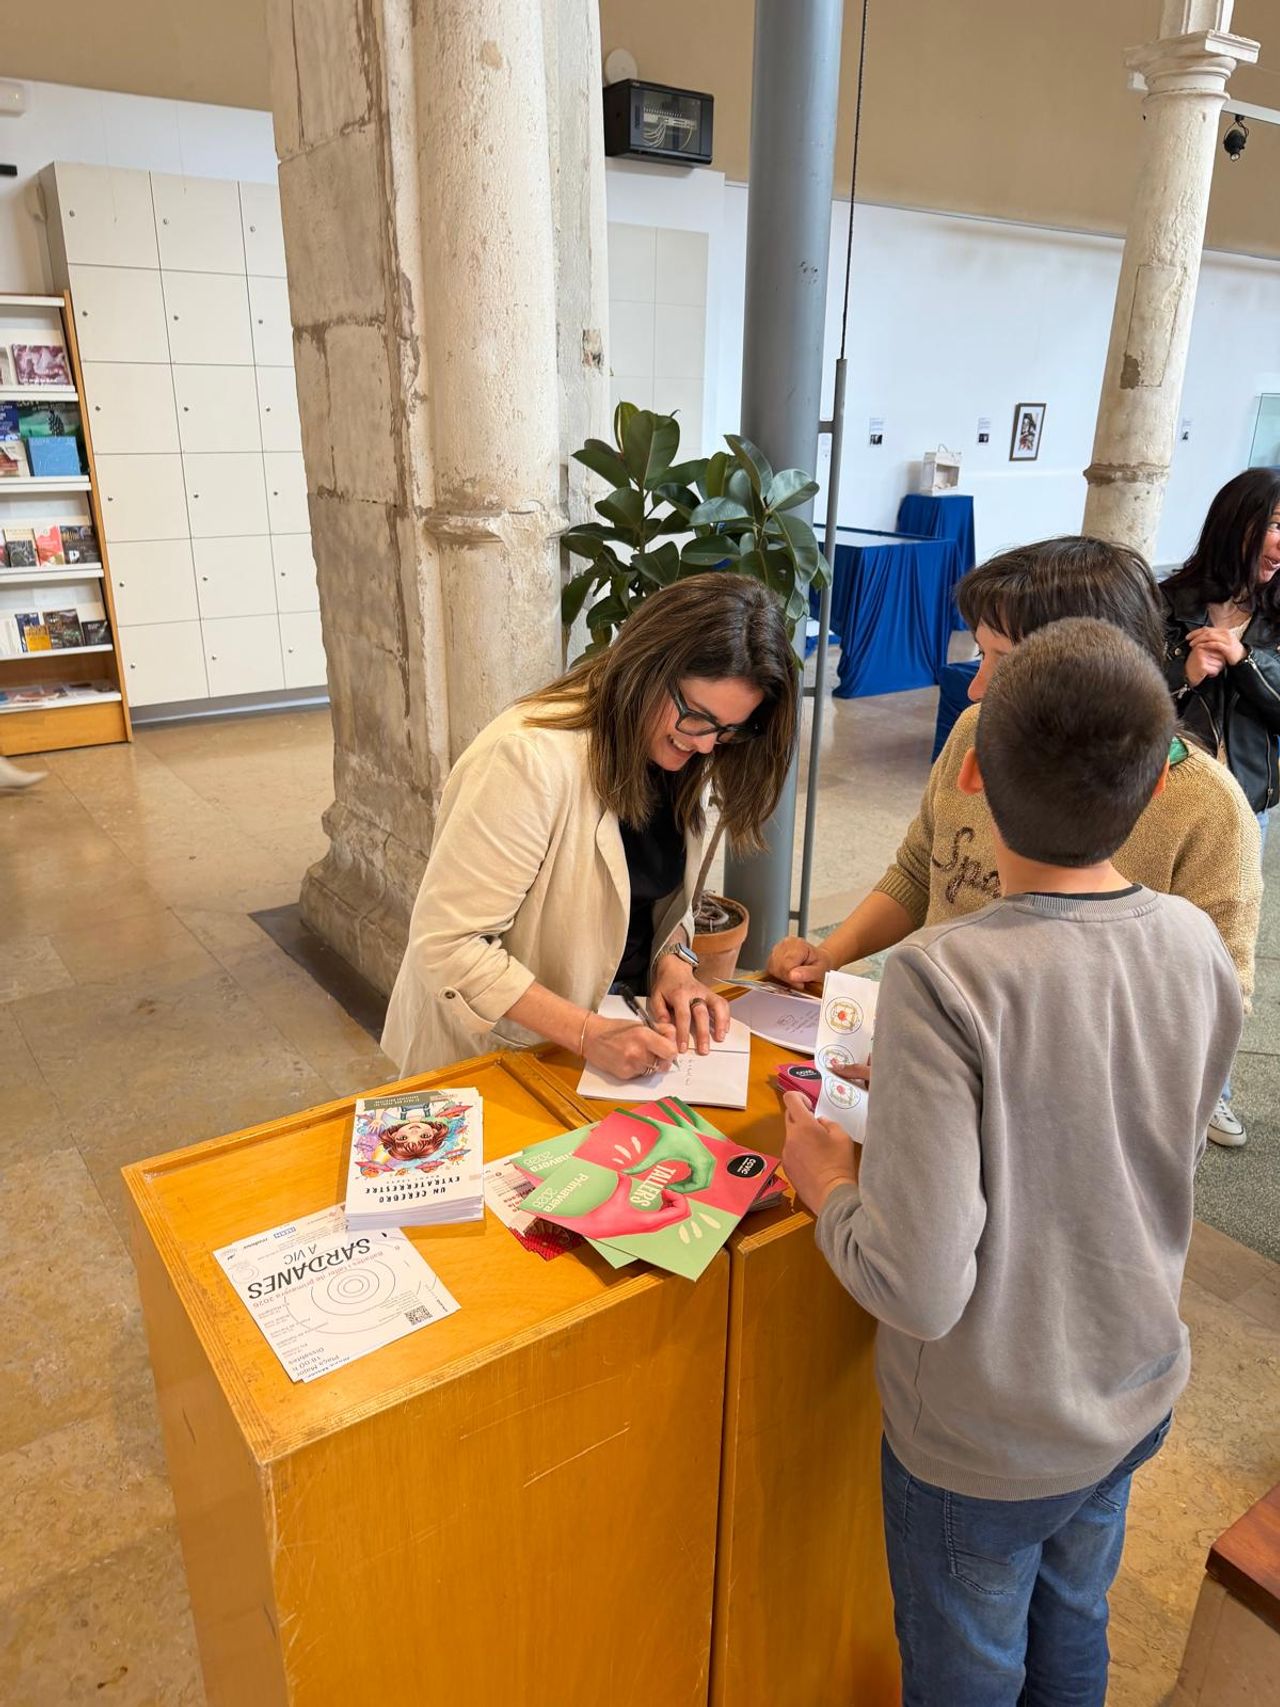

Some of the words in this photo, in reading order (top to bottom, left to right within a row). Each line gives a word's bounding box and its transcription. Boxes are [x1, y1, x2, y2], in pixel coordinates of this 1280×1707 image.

[529, 1152, 573, 1173] mavera
[365, 1176, 460, 1194] EXTRATERRESTRE
[433, 1187, 446, 1195] UN
[543, 1172, 589, 1213] Primavera
[630, 1164, 677, 1207] TALLERS
[378, 1191, 427, 1203] CEREBRO
[283, 1249, 306, 1265] VIC
[308, 1243, 317, 1255] A
[247, 1238, 371, 1300] SARDANES
[276, 1279, 315, 1297] primavera
